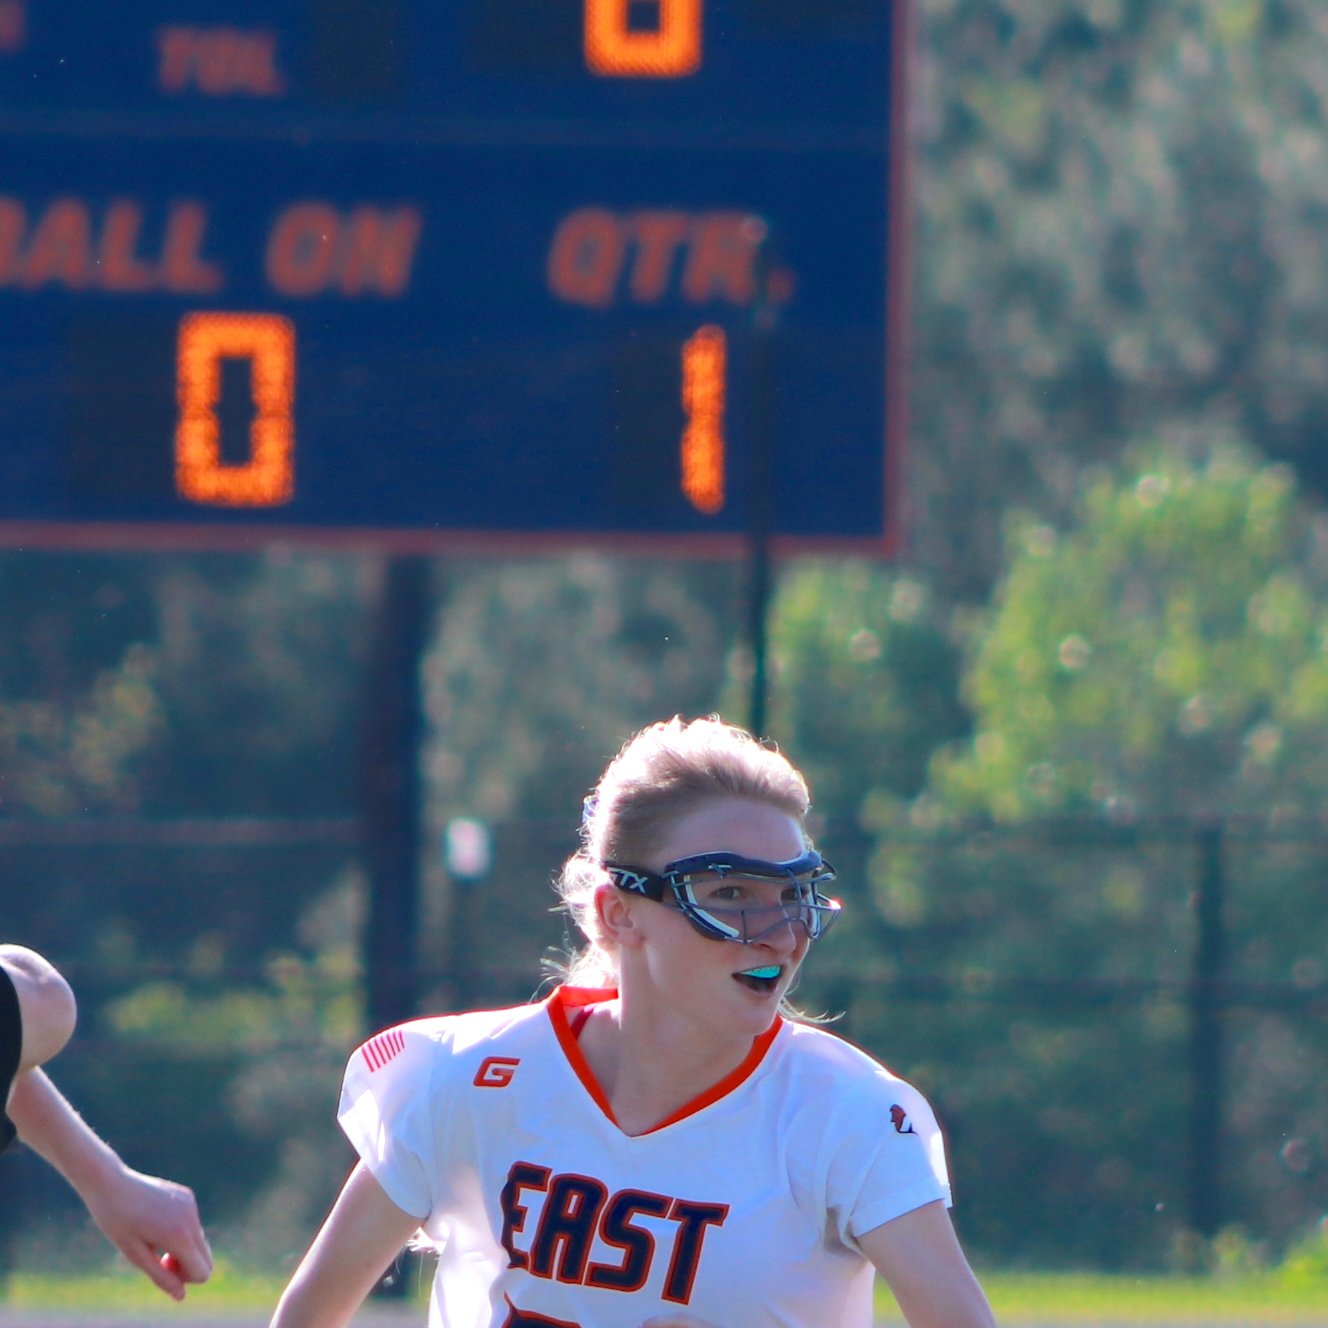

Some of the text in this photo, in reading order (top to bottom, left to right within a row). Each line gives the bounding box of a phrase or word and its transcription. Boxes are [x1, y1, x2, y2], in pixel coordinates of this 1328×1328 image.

[268, 200, 421, 297] ON
[176, 310, 297, 506] 0
[681, 323, 726, 514] 1
[500, 1160, 730, 1306] EAST
